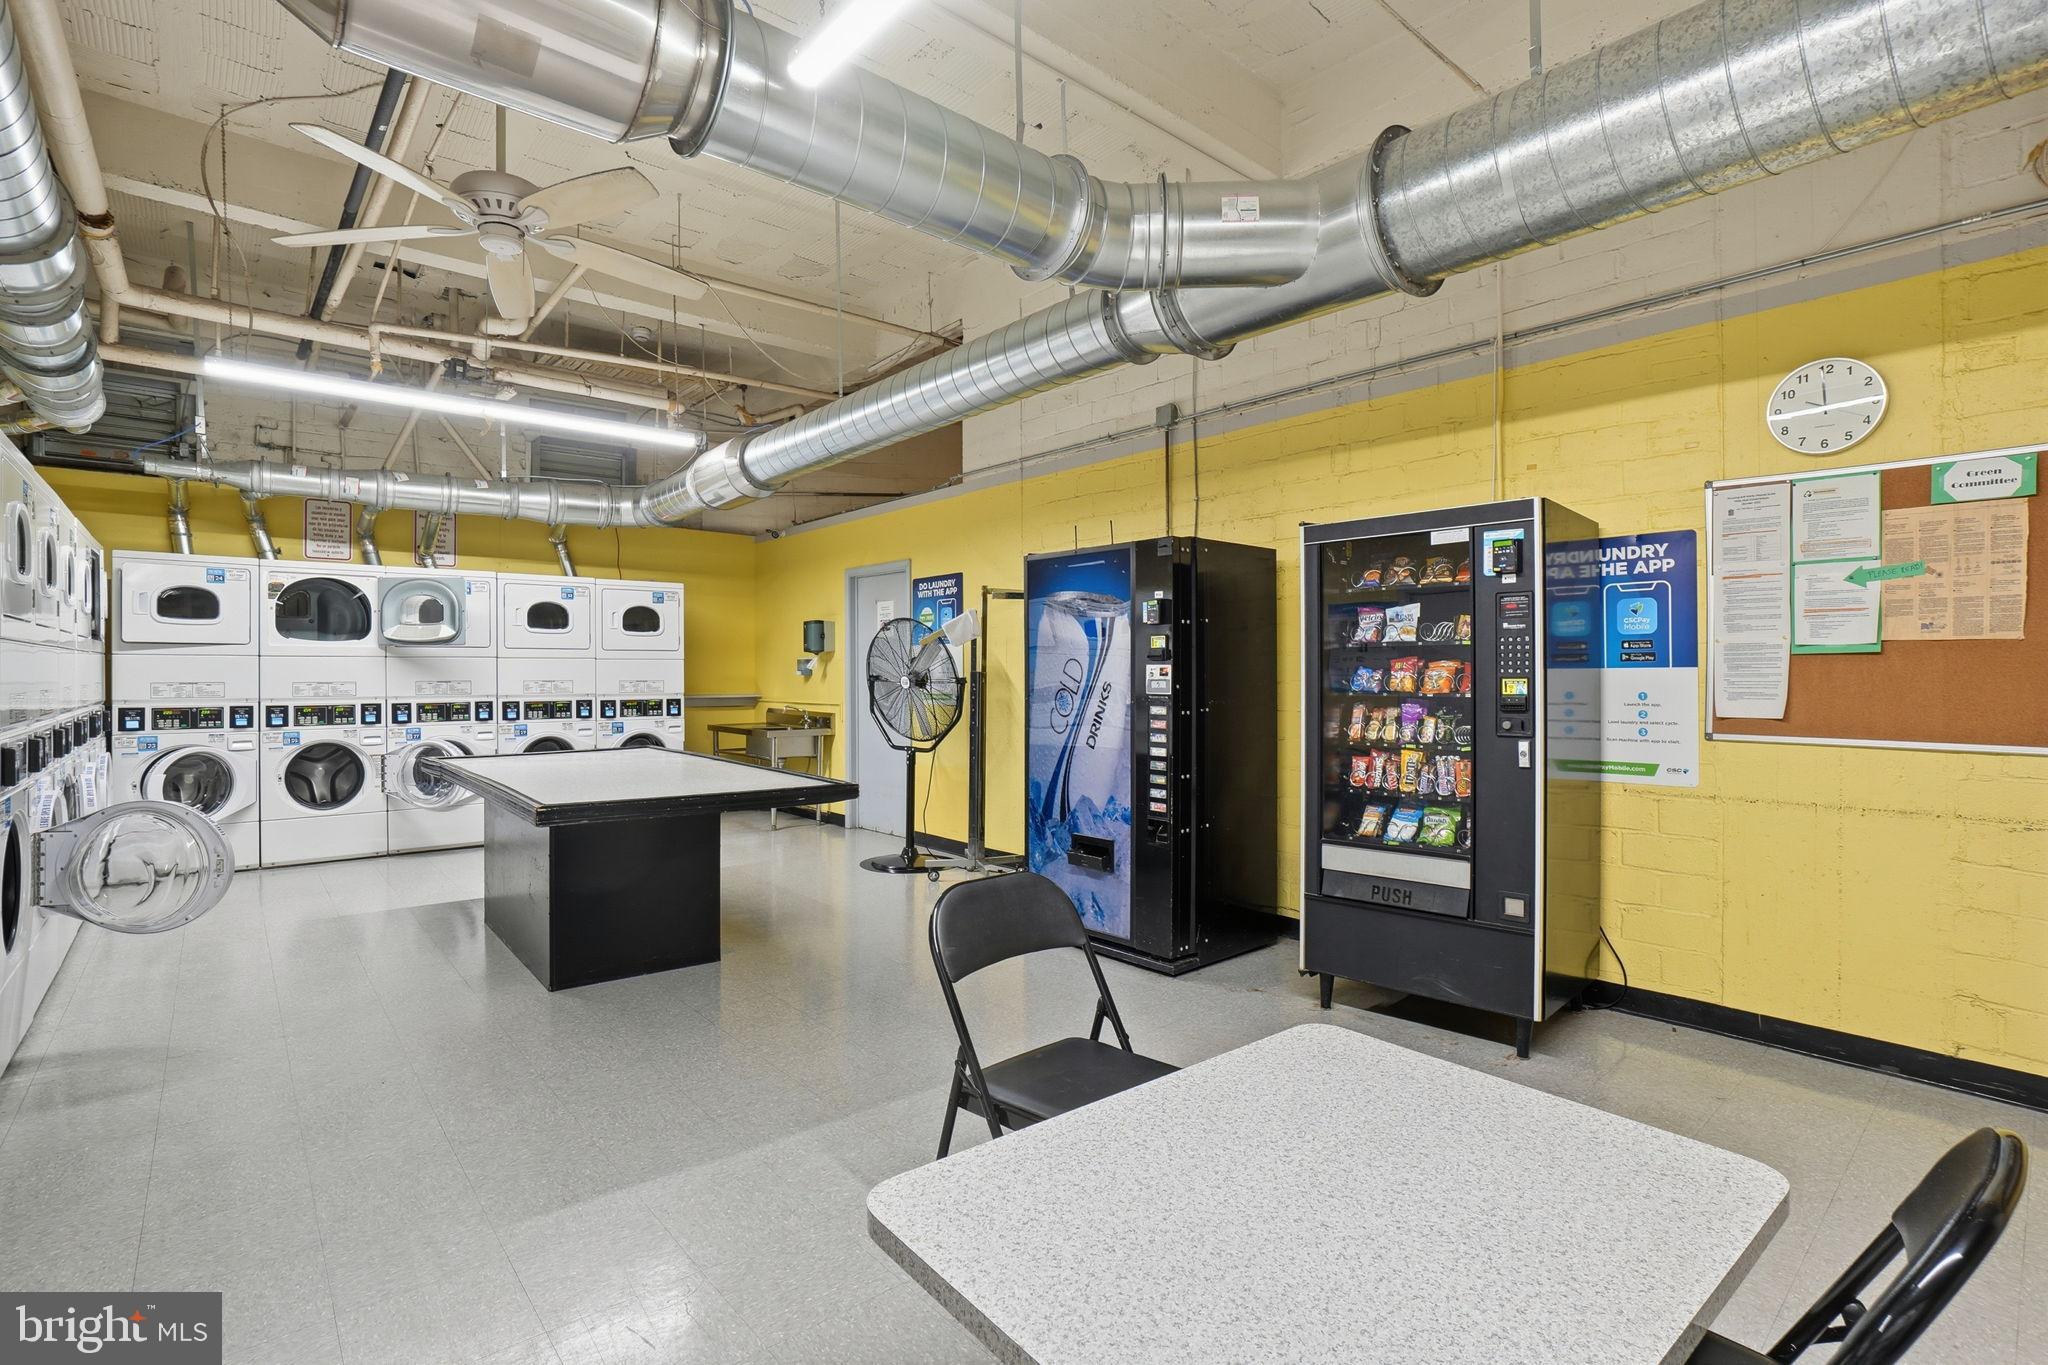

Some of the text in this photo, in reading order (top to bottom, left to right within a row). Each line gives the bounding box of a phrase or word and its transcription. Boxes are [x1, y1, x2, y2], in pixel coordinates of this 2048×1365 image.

[1819, 364, 1834, 374] 12
[1846, 366, 1853, 375] 1
[1796, 373, 1809, 384] 11
[1864, 376, 1873, 386] 2
[1781, 389, 1796, 400] 10
[1863, 415, 1871, 424] 4
[1781, 426, 1789, 435] 8
[1844, 430, 1853, 440] 5
[1798, 436, 1807, 446] 7
[1820, 439, 1829, 448] 6
[1966, 468, 2002, 477] Green
[1951, 477, 2018, 488] Committee
[1598, 543, 1670, 562] UNDRY
[1599, 559, 1676, 577] HE APP
[1867, 568, 1896, 579] PLEASE
[918, 578, 956, 590] DO LAUNDRY
[917, 586, 958, 599] WITH THE APP
[1050, 658, 1084, 735] COLD
[1086, 681, 1112, 750] DRINKS
[1371, 884, 1413, 906] PUSH
